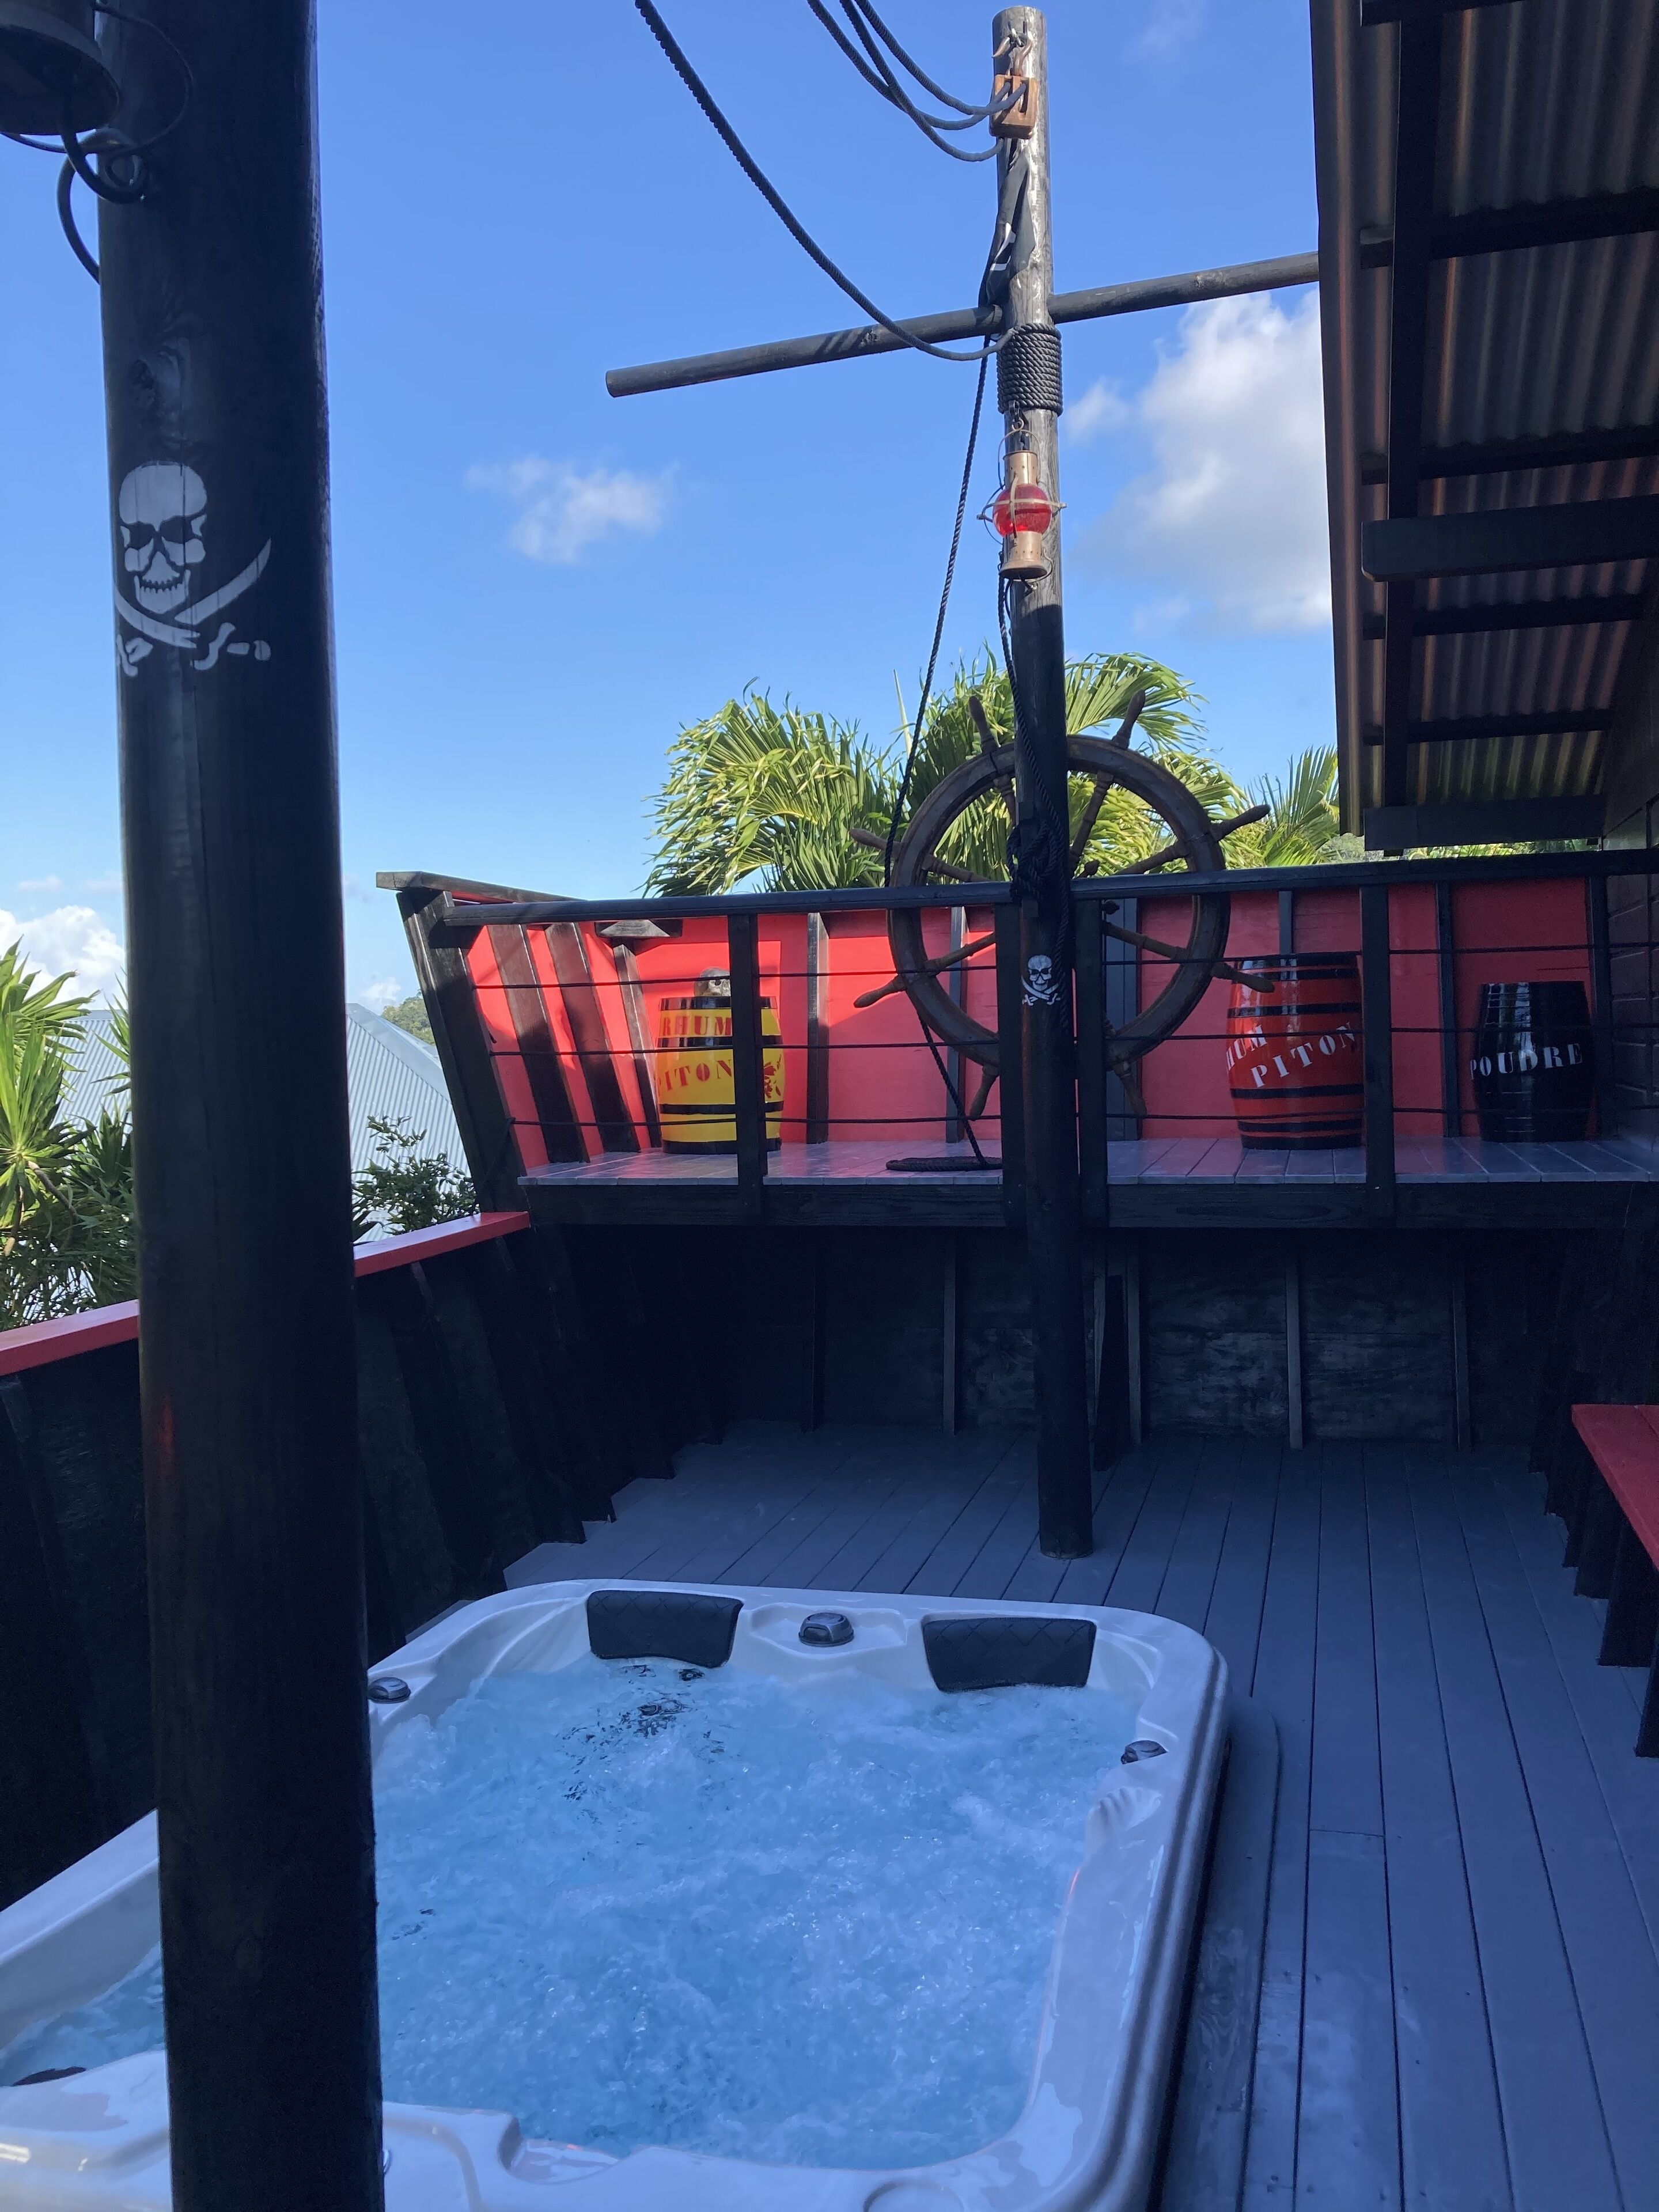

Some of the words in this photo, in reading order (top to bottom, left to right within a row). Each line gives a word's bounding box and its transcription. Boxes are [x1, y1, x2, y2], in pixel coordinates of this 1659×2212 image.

[662, 1016, 732, 1036] RHUM
[1226, 1024, 1268, 1074] HUM
[1250, 1021, 1355, 1088] PITON
[1470, 1043, 1583, 1080] POUDRE
